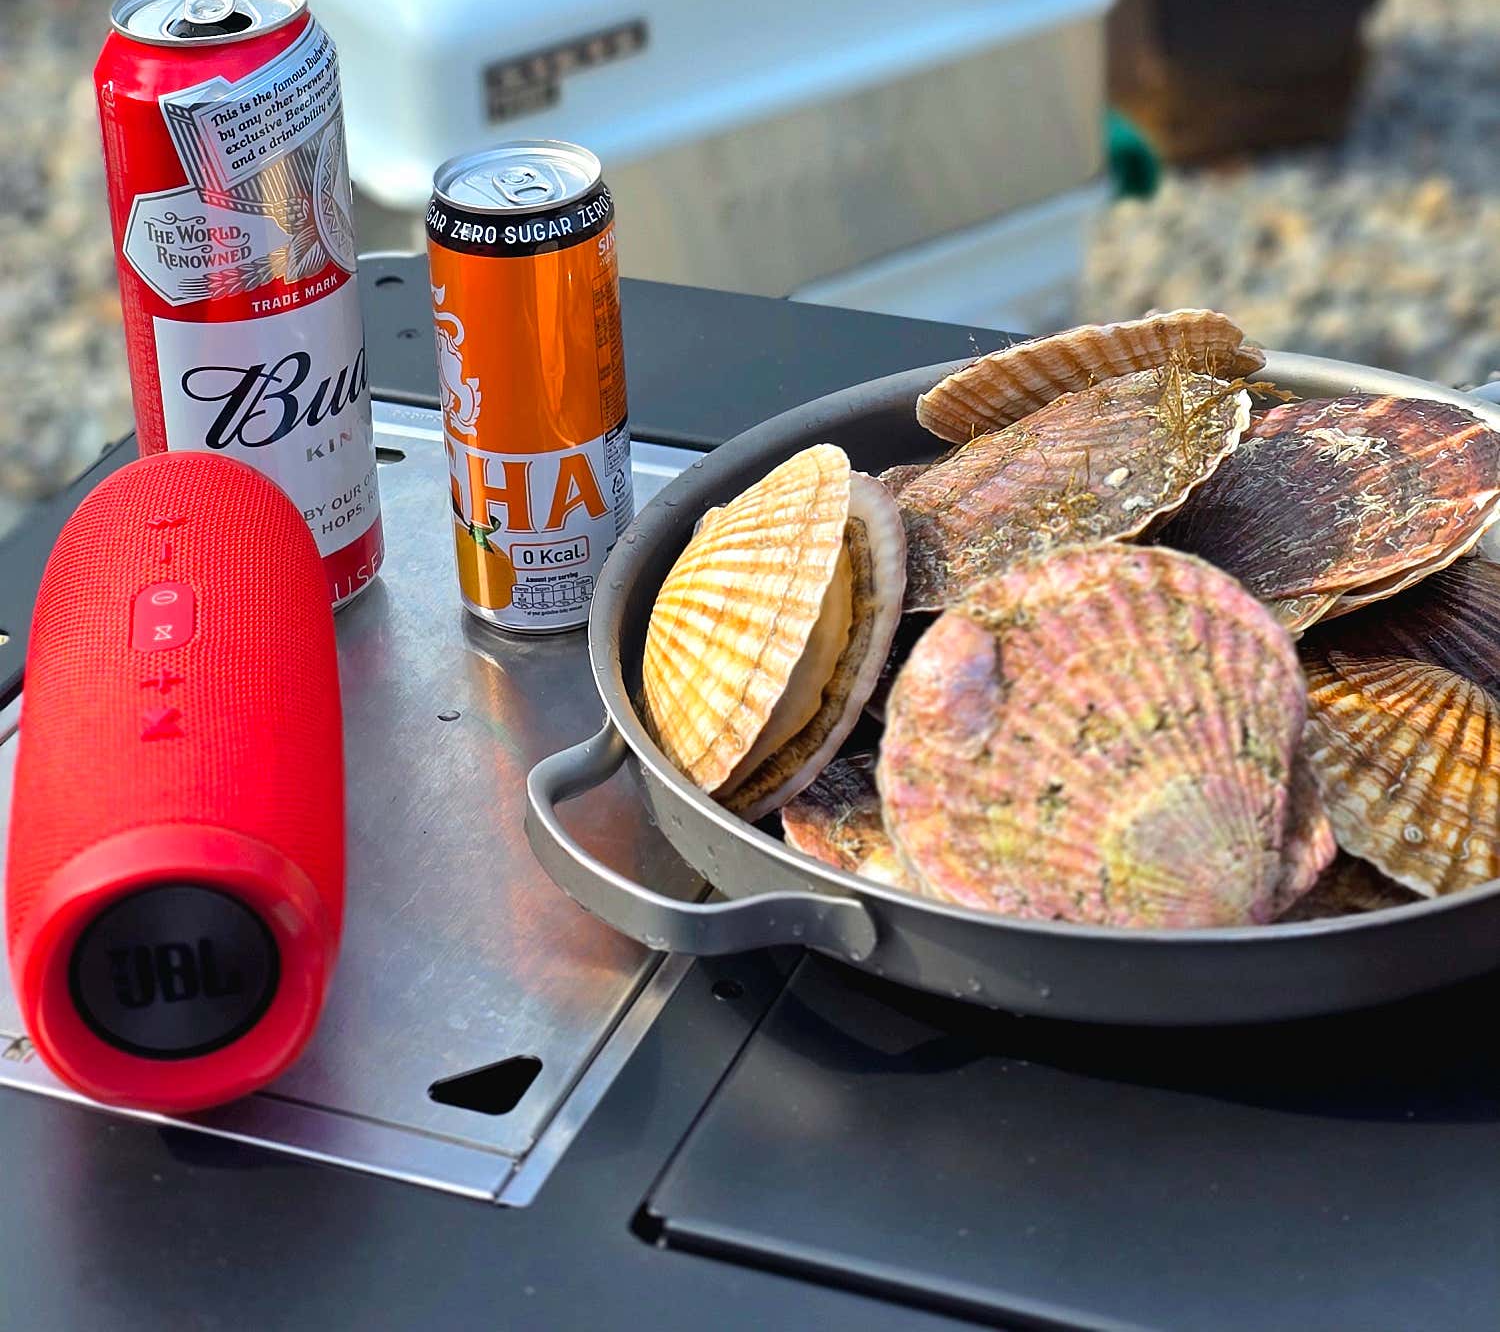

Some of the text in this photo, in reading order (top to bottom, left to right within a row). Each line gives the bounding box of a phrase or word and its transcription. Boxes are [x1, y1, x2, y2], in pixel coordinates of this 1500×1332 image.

[211, 108, 239, 127] This
[239, 102, 252, 114] is
[252, 90, 272, 107] the
[273, 66, 308, 98] famous
[217, 128, 236, 142] by
[238, 114, 262, 132] any
[265, 94, 294, 117] other
[296, 69, 325, 98] brewer
[225, 75, 333, 155] exclusive Beechwood
[231, 151, 256, 170] and
[258, 146, 267, 155] a
[269, 102, 326, 149] drinkability
[143, 220, 250, 248] THE WORLD
[426, 200, 609, 245] GAR ZERO SUGAR ZERO
[155, 245, 252, 270] RENOWNED
[252, 273, 339, 313] TRADE MARK
[303, 504, 326, 522] BY
[331, 484, 362, 511] OUR
[523, 544, 586, 565] 0 Kcal.
[108, 936, 242, 1009] JBL
